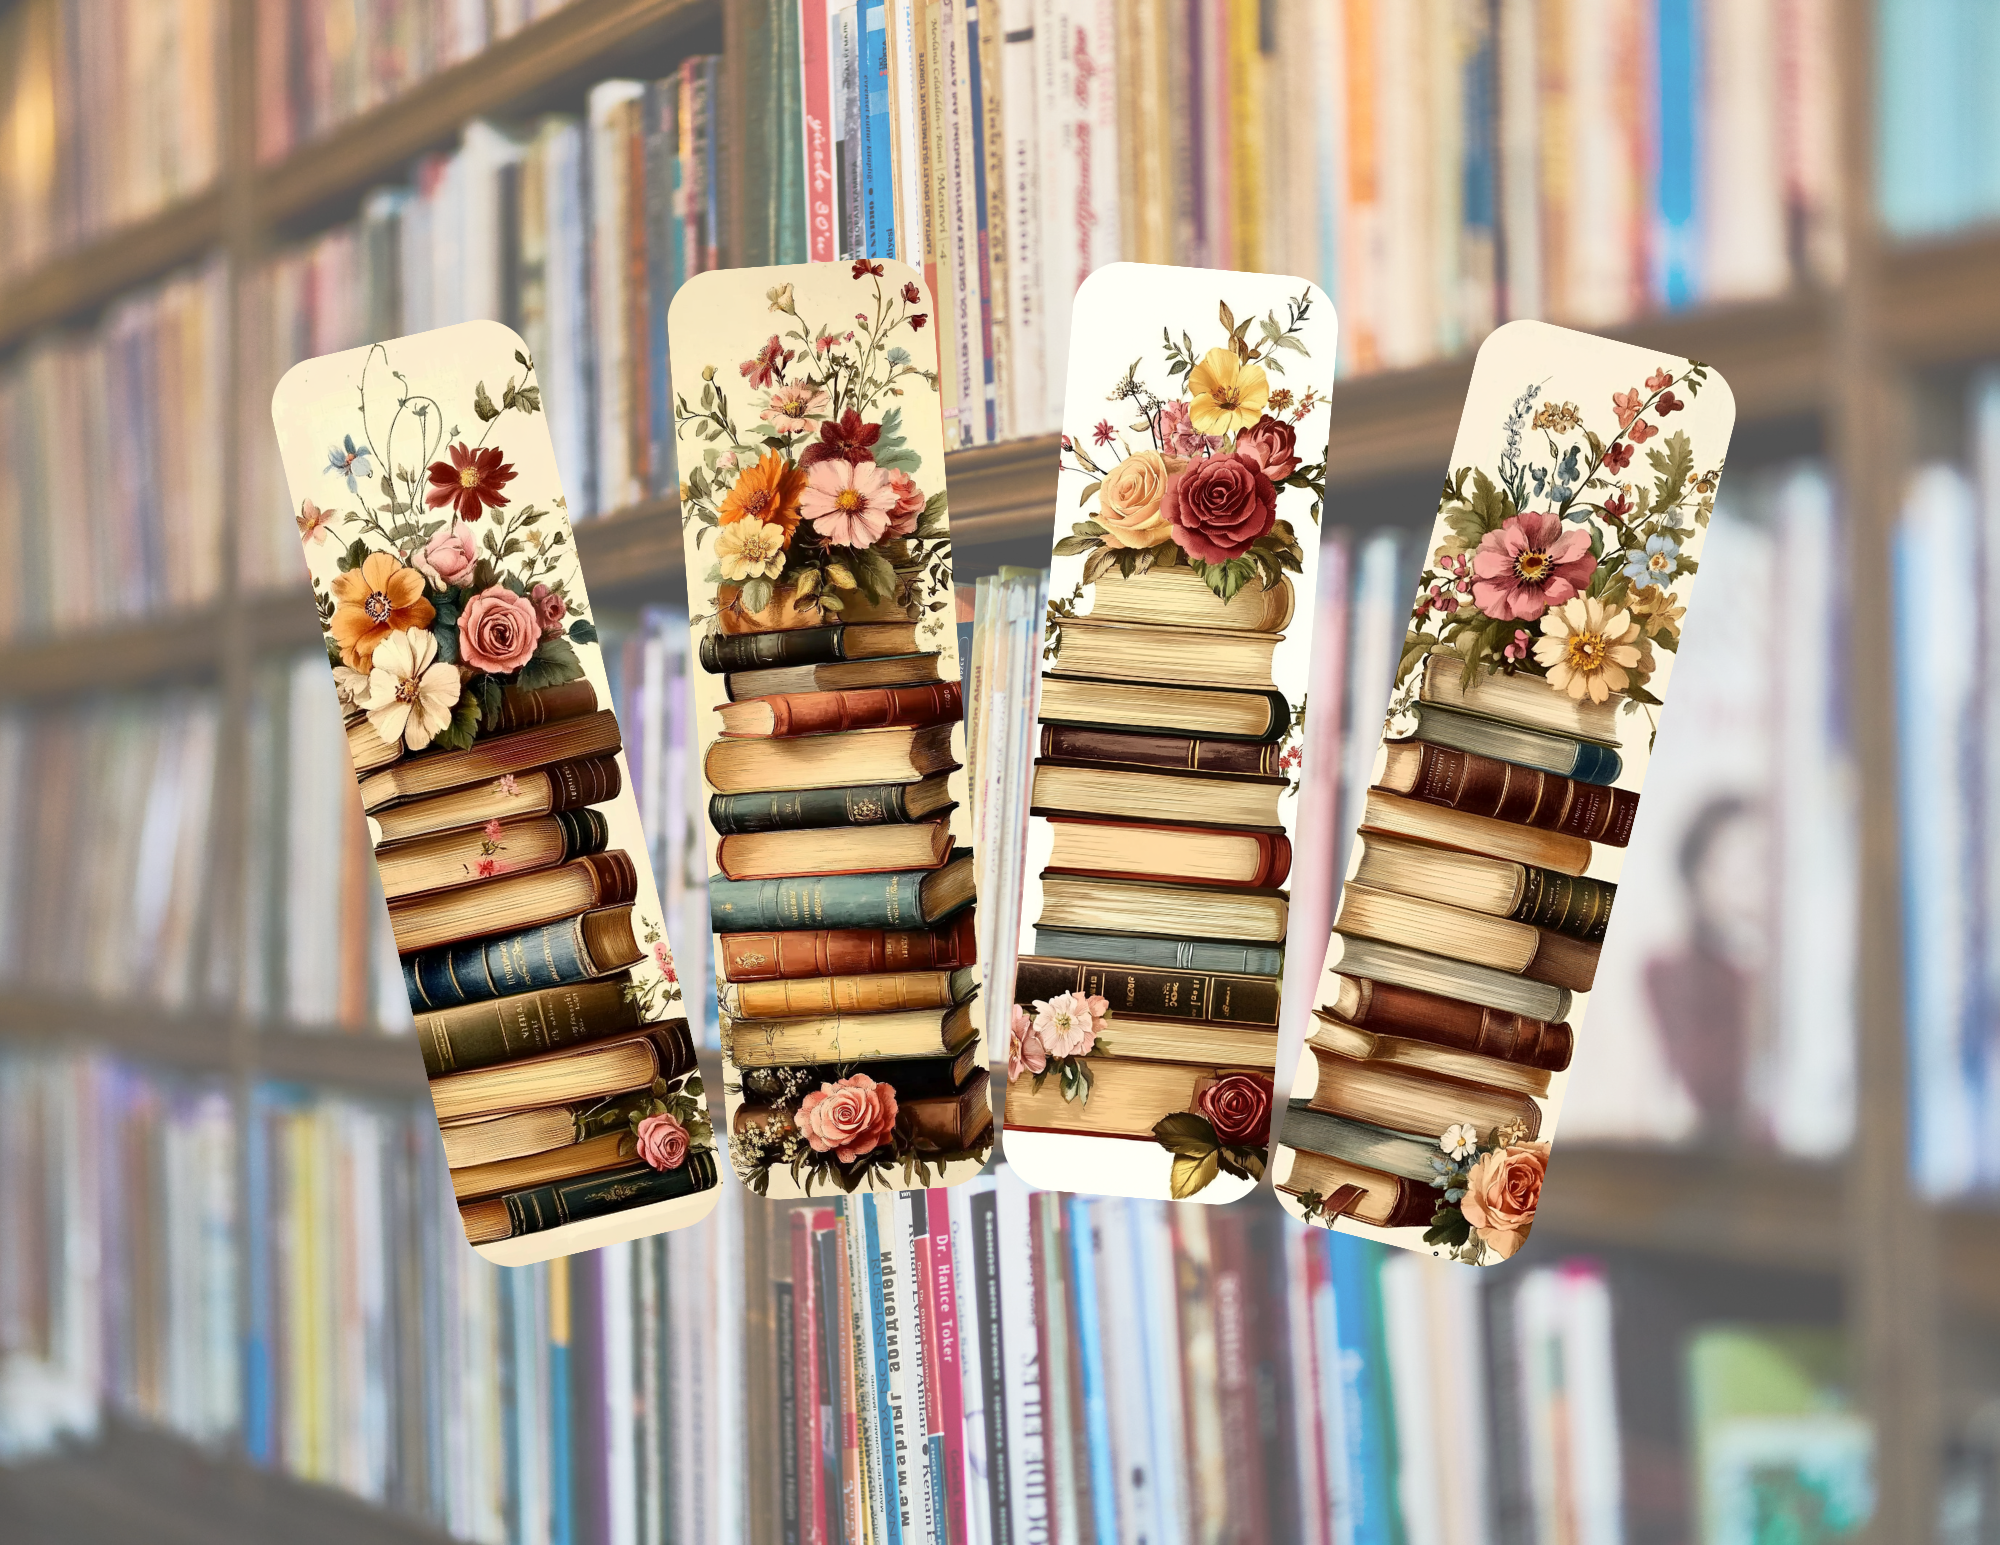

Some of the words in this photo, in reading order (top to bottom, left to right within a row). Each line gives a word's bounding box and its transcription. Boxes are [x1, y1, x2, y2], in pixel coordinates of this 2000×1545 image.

[917, 52, 926, 90] TÜRKİYE
[919, 91, 927, 104] VE
[920, 105, 930, 165] İŞLETMELERİ
[952, 121, 962, 178] KENDİNİ
[923, 167, 931, 201] DEVLET
[924, 203, 933, 255] KAPİTALİST
[957, 235, 967, 292] GELECEK
[959, 294, 968, 320] SOL
[960, 321, 968, 340] VE
[961, 340, 971, 399] YEŞİLLER
[936, 1235, 948, 1258] Dr.
[871, 1257, 885, 1348] RUSSIAN
[937, 1264, 951, 1313] Hatice
[920, 1308, 928, 1341] Dilara
[941, 1318, 955, 1363] Toker
[878, 1357, 889, 1394] ON
[922, 1343, 932, 1389] Sevimay
[870, 1373, 878, 1412] IMAGING
[926, 1393, 934, 1419] Özer
[874, 1415, 882, 1467] RESONANCE
[881, 1403, 892, 1467] YOUR
[922, 1464, 936, 1526] Kenan
[930, 1443, 939, 1510] ENGELLİLER
[886, 1477, 898, 1538] OWN
